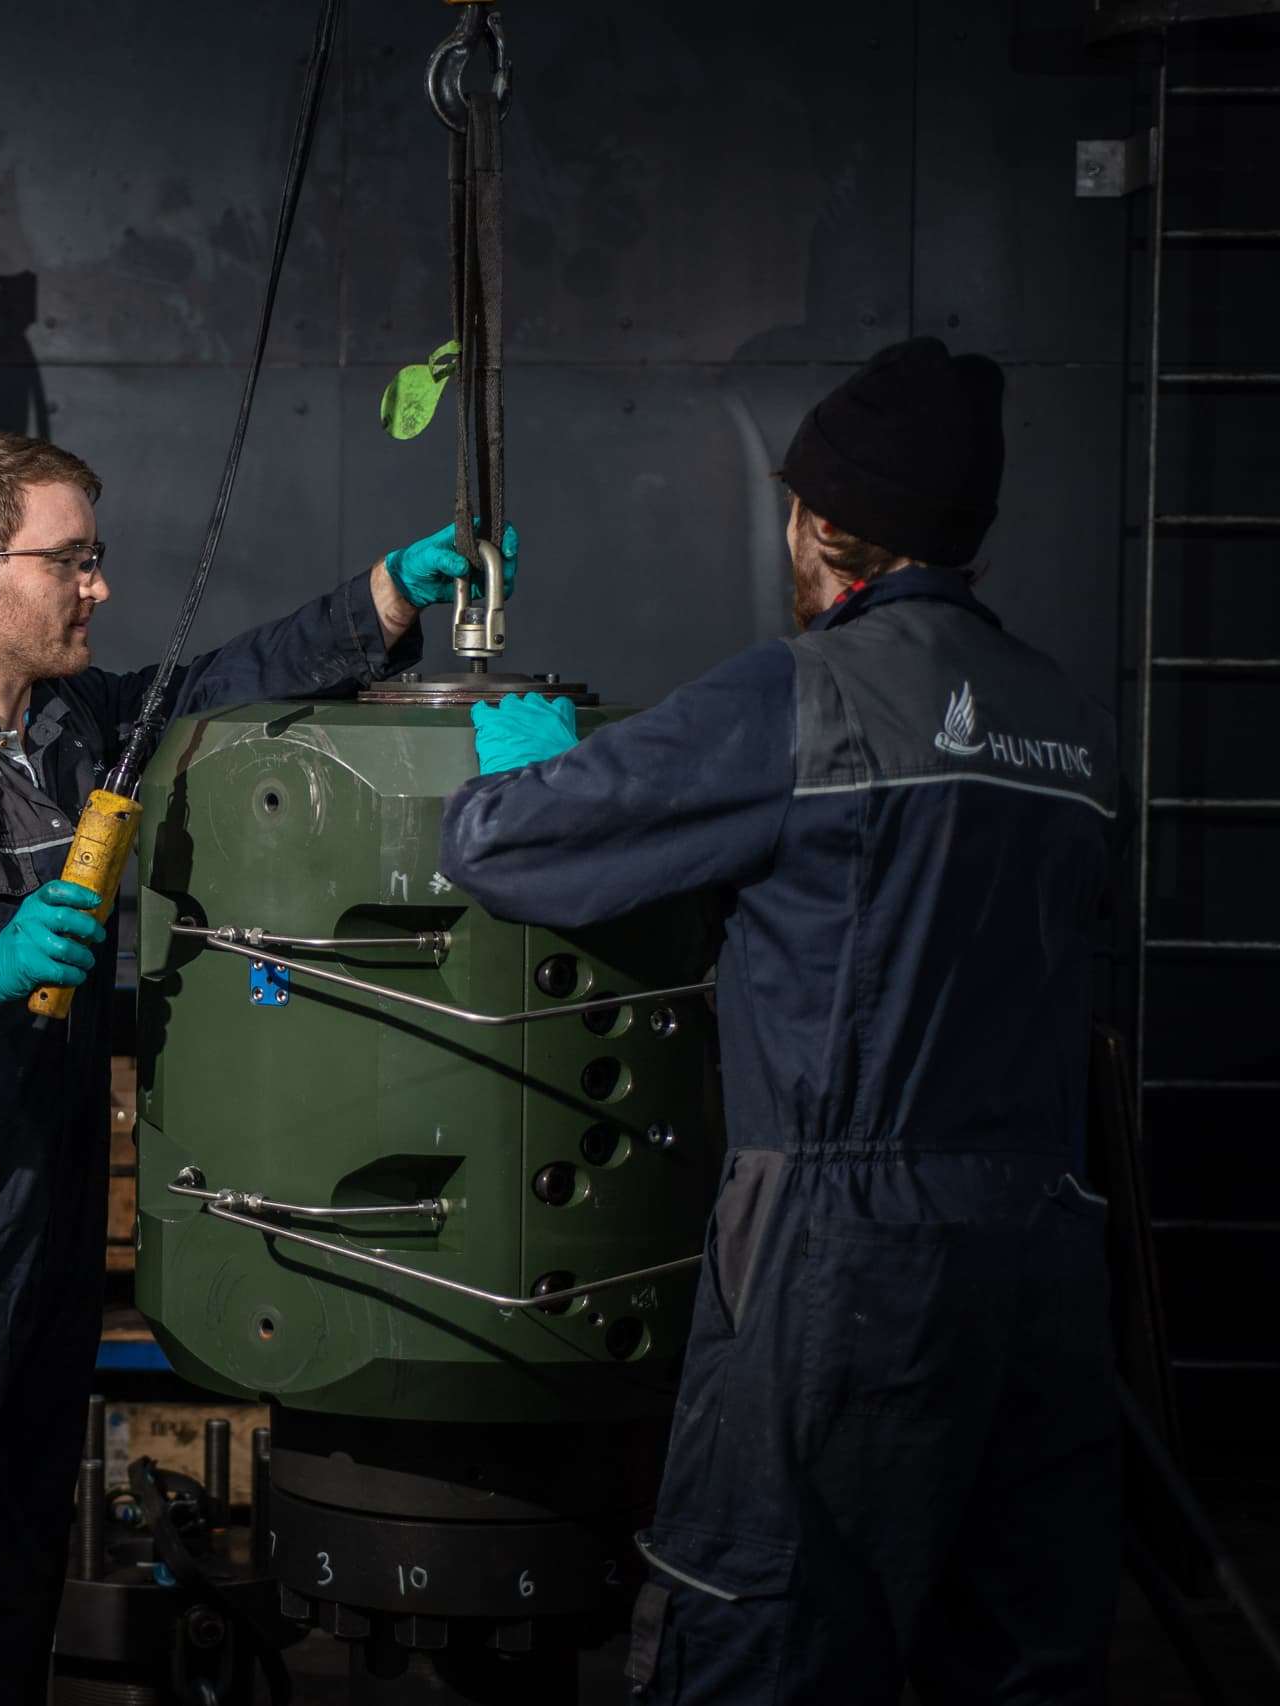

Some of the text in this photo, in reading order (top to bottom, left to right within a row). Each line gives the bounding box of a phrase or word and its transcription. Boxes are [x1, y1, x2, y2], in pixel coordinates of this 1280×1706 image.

[987, 730, 1093, 778] HUNTING
[316, 1551, 334, 1586] 3
[398, 1564, 428, 1596] 10
[518, 1568, 535, 1597] 6
